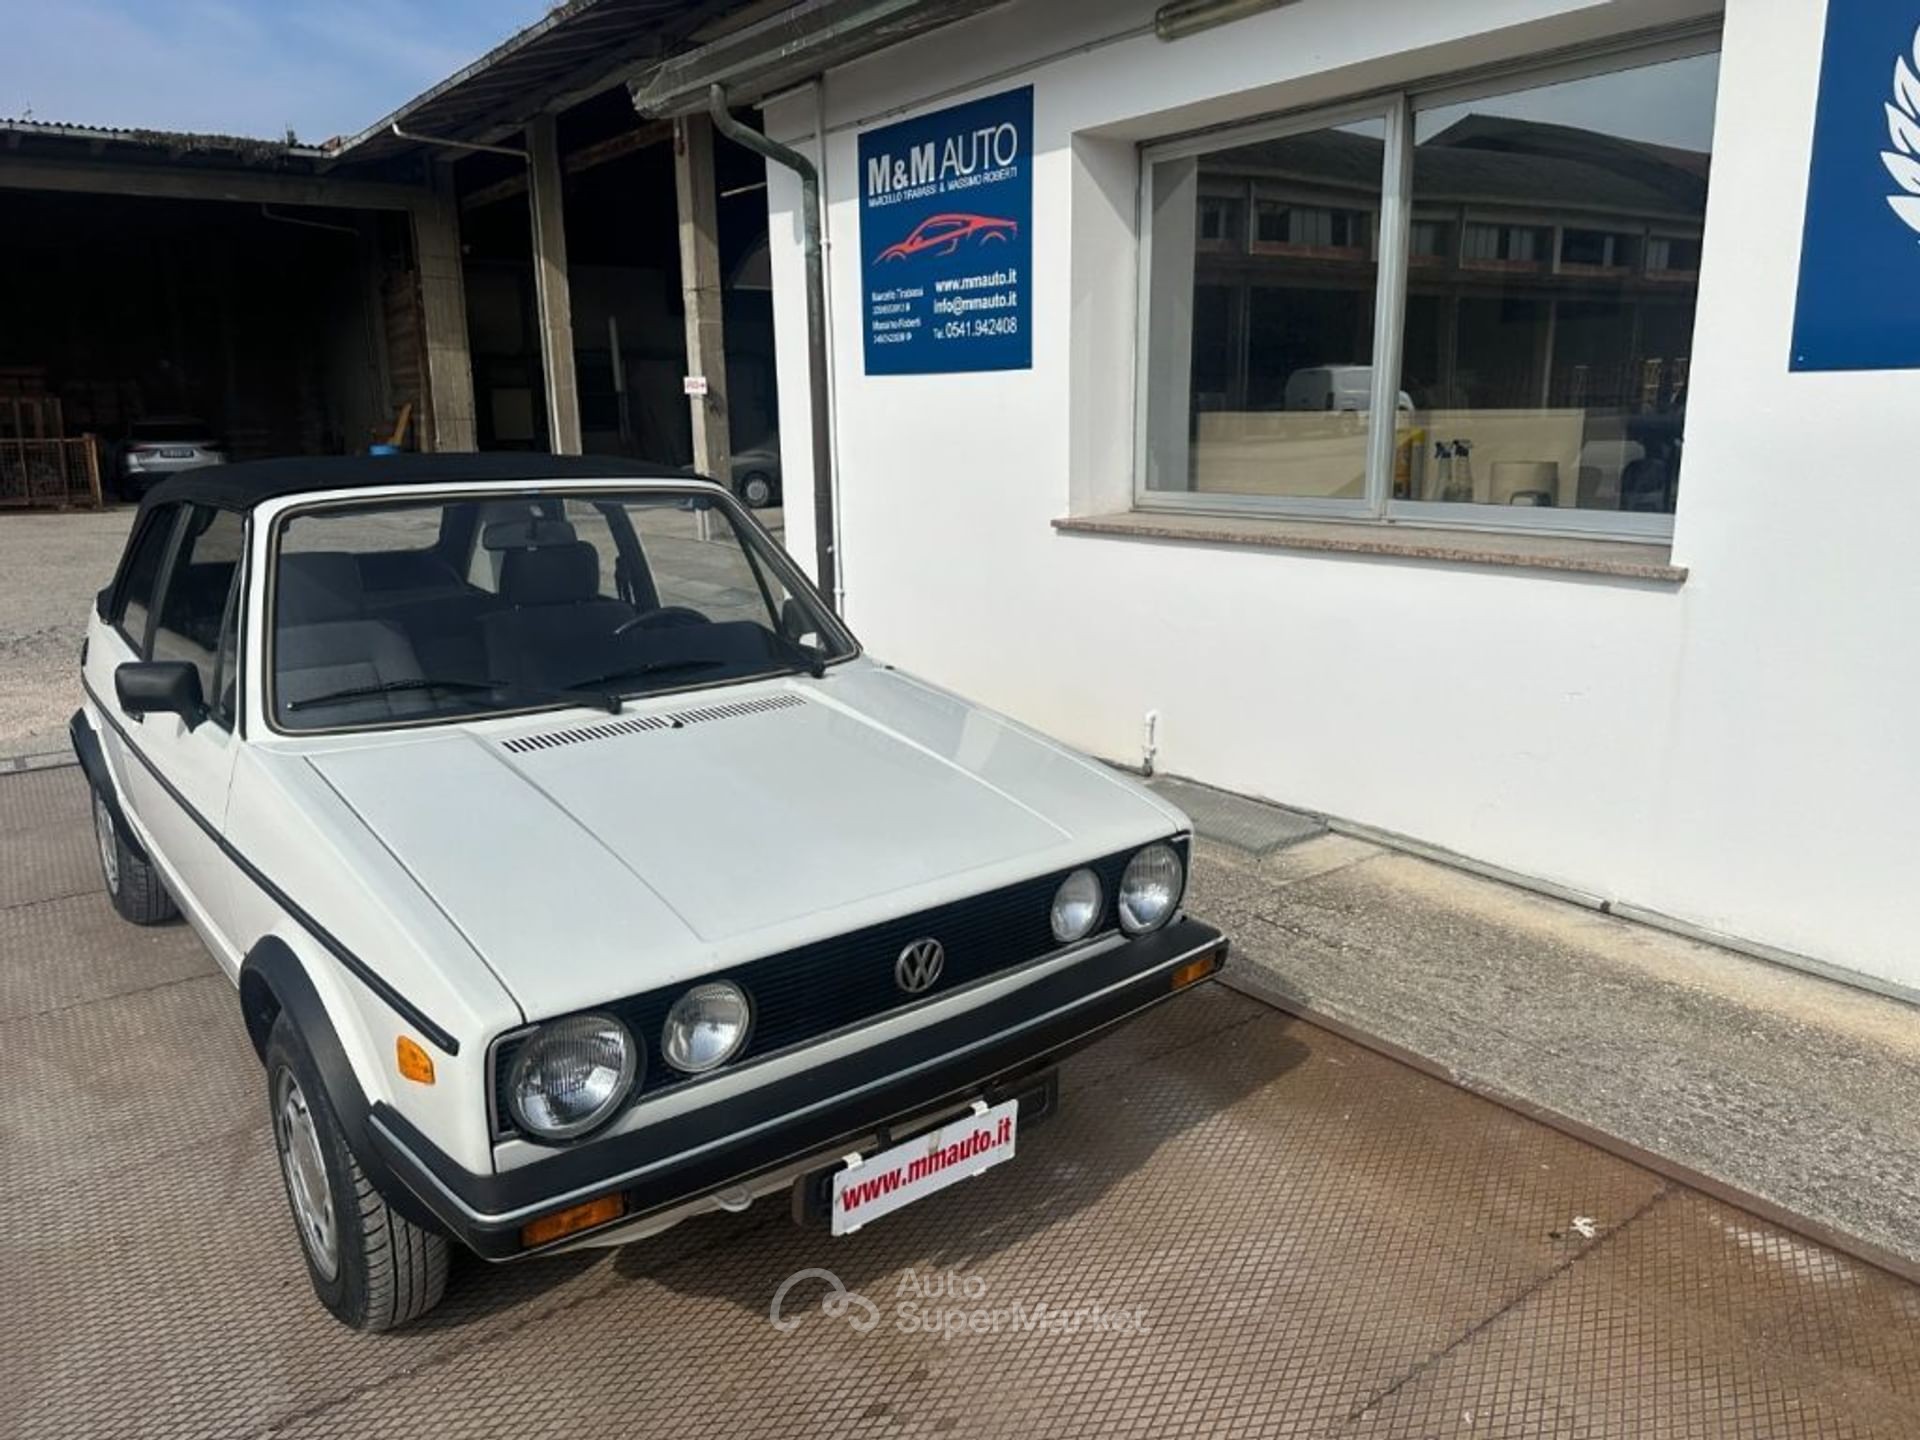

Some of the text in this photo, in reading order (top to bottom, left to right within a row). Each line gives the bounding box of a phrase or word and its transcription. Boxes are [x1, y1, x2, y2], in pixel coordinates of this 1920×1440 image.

[868, 122, 1018, 196] M&M AUTO
[935, 268, 1017, 292] www.mmauto.it
[933, 291, 1017, 316] info@mmauto.it
[945, 316, 1018, 339] 0541.942408
[841, 1116, 1012, 1212] www.mmauto.it
